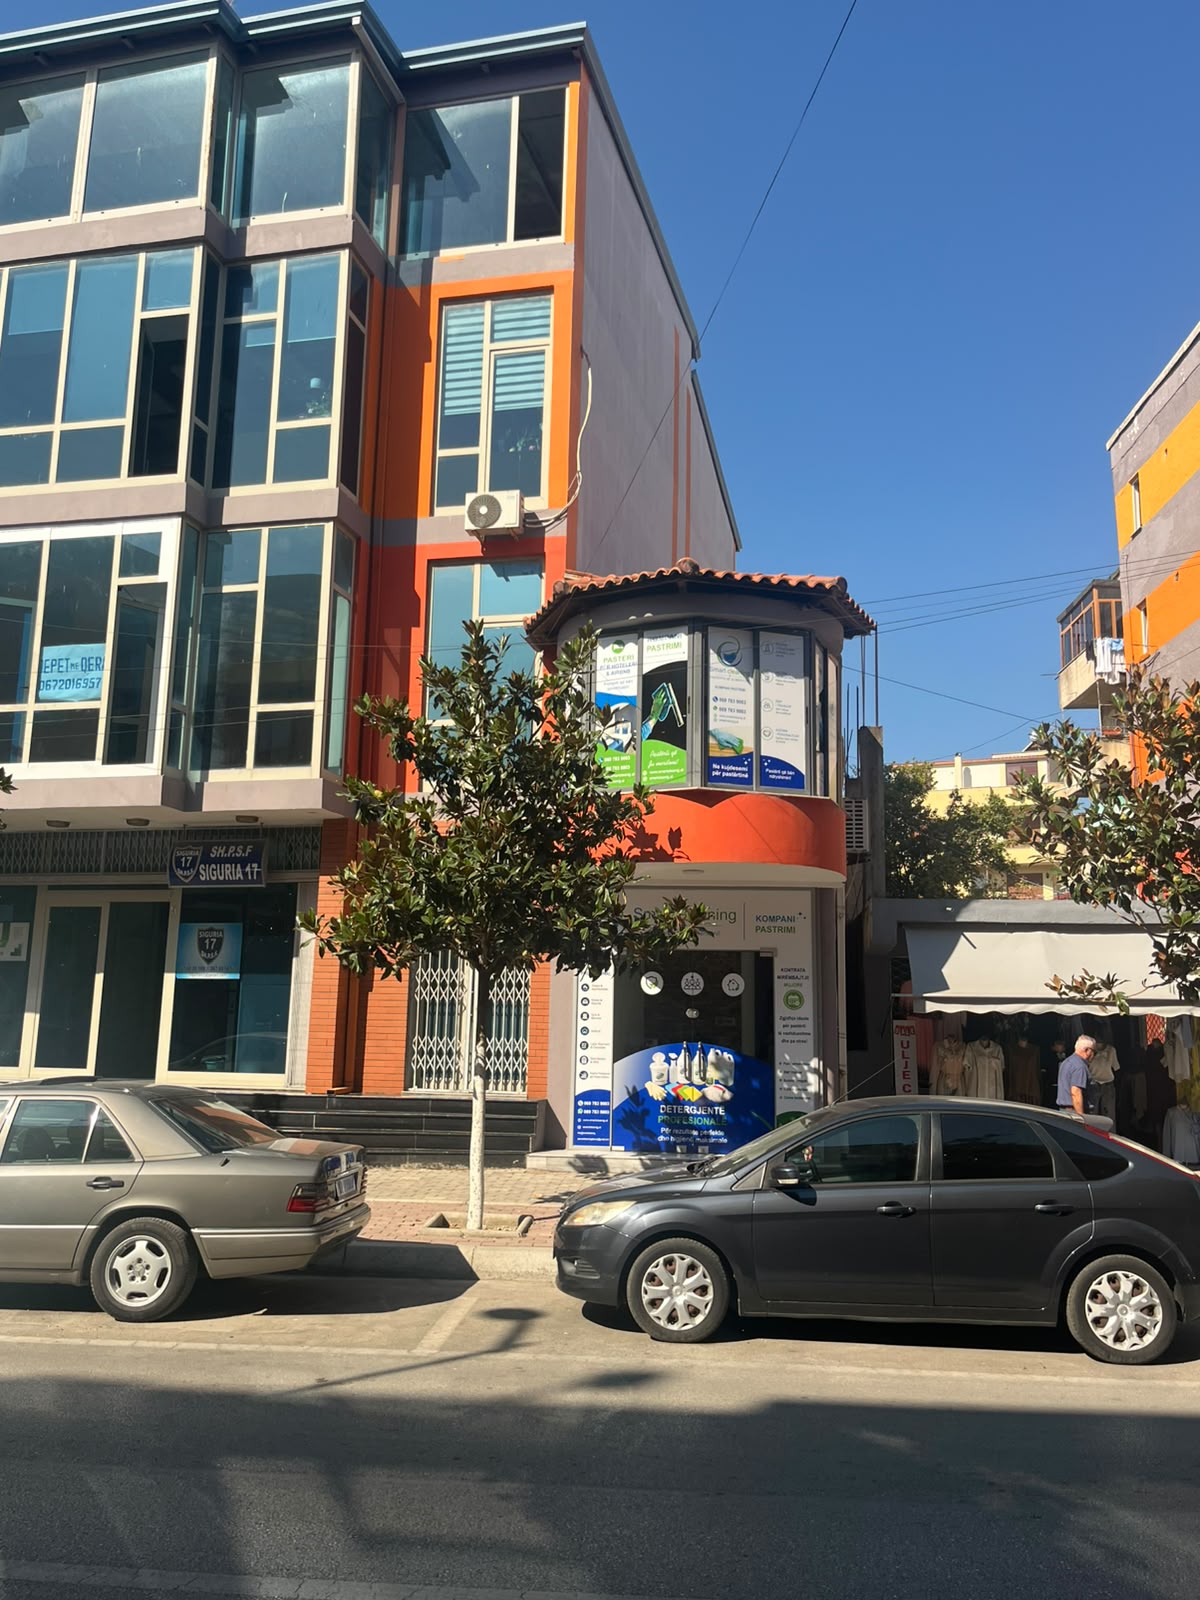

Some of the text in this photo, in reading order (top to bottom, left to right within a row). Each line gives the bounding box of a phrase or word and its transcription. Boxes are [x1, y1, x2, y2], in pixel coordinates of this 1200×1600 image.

[646, 641, 682, 653] PASTRIMI
[38, 677, 102, 691] 0672016957
[210, 845, 254, 858] SH.P.S.F
[180, 856, 193, 867] 17
[199, 863, 259, 881] SIGURIA 17
[755, 914, 796, 924] KOMPANI
[199, 930, 224, 938] SIGURIA
[755, 925, 796, 934] PASTRIMI
[204, 938, 217, 950] 17
[660, 1127, 672, 1135] Për
